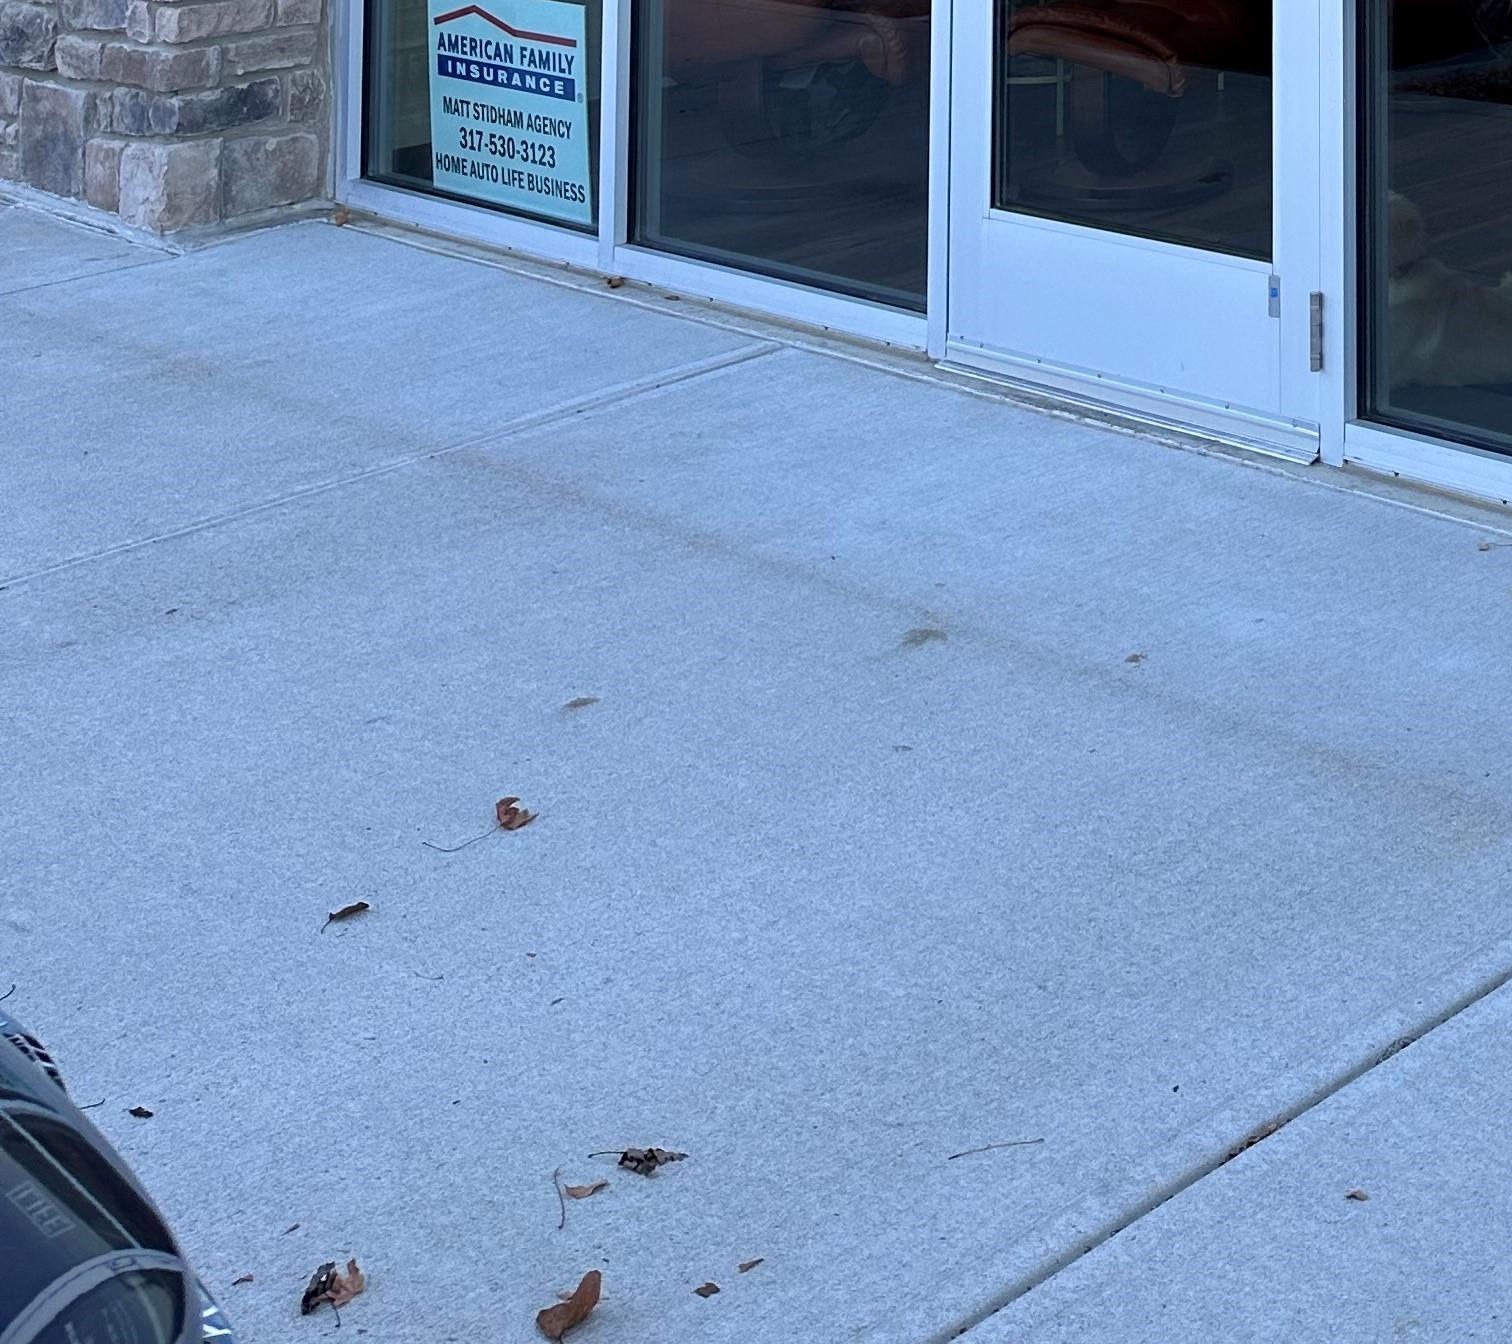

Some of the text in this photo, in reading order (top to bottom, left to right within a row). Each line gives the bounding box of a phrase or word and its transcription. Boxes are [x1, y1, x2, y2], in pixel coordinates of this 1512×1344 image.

[437, 31, 575, 75] AMERICAN FAMILY
[447, 60, 565, 95] INSURANCE
[442, 95, 572, 140] MATT STIDHAM AGENCY
[459, 126, 556, 169] 317-530-3123
[435, 152, 586, 204] HOME AUTO LIFE BUSINESS
